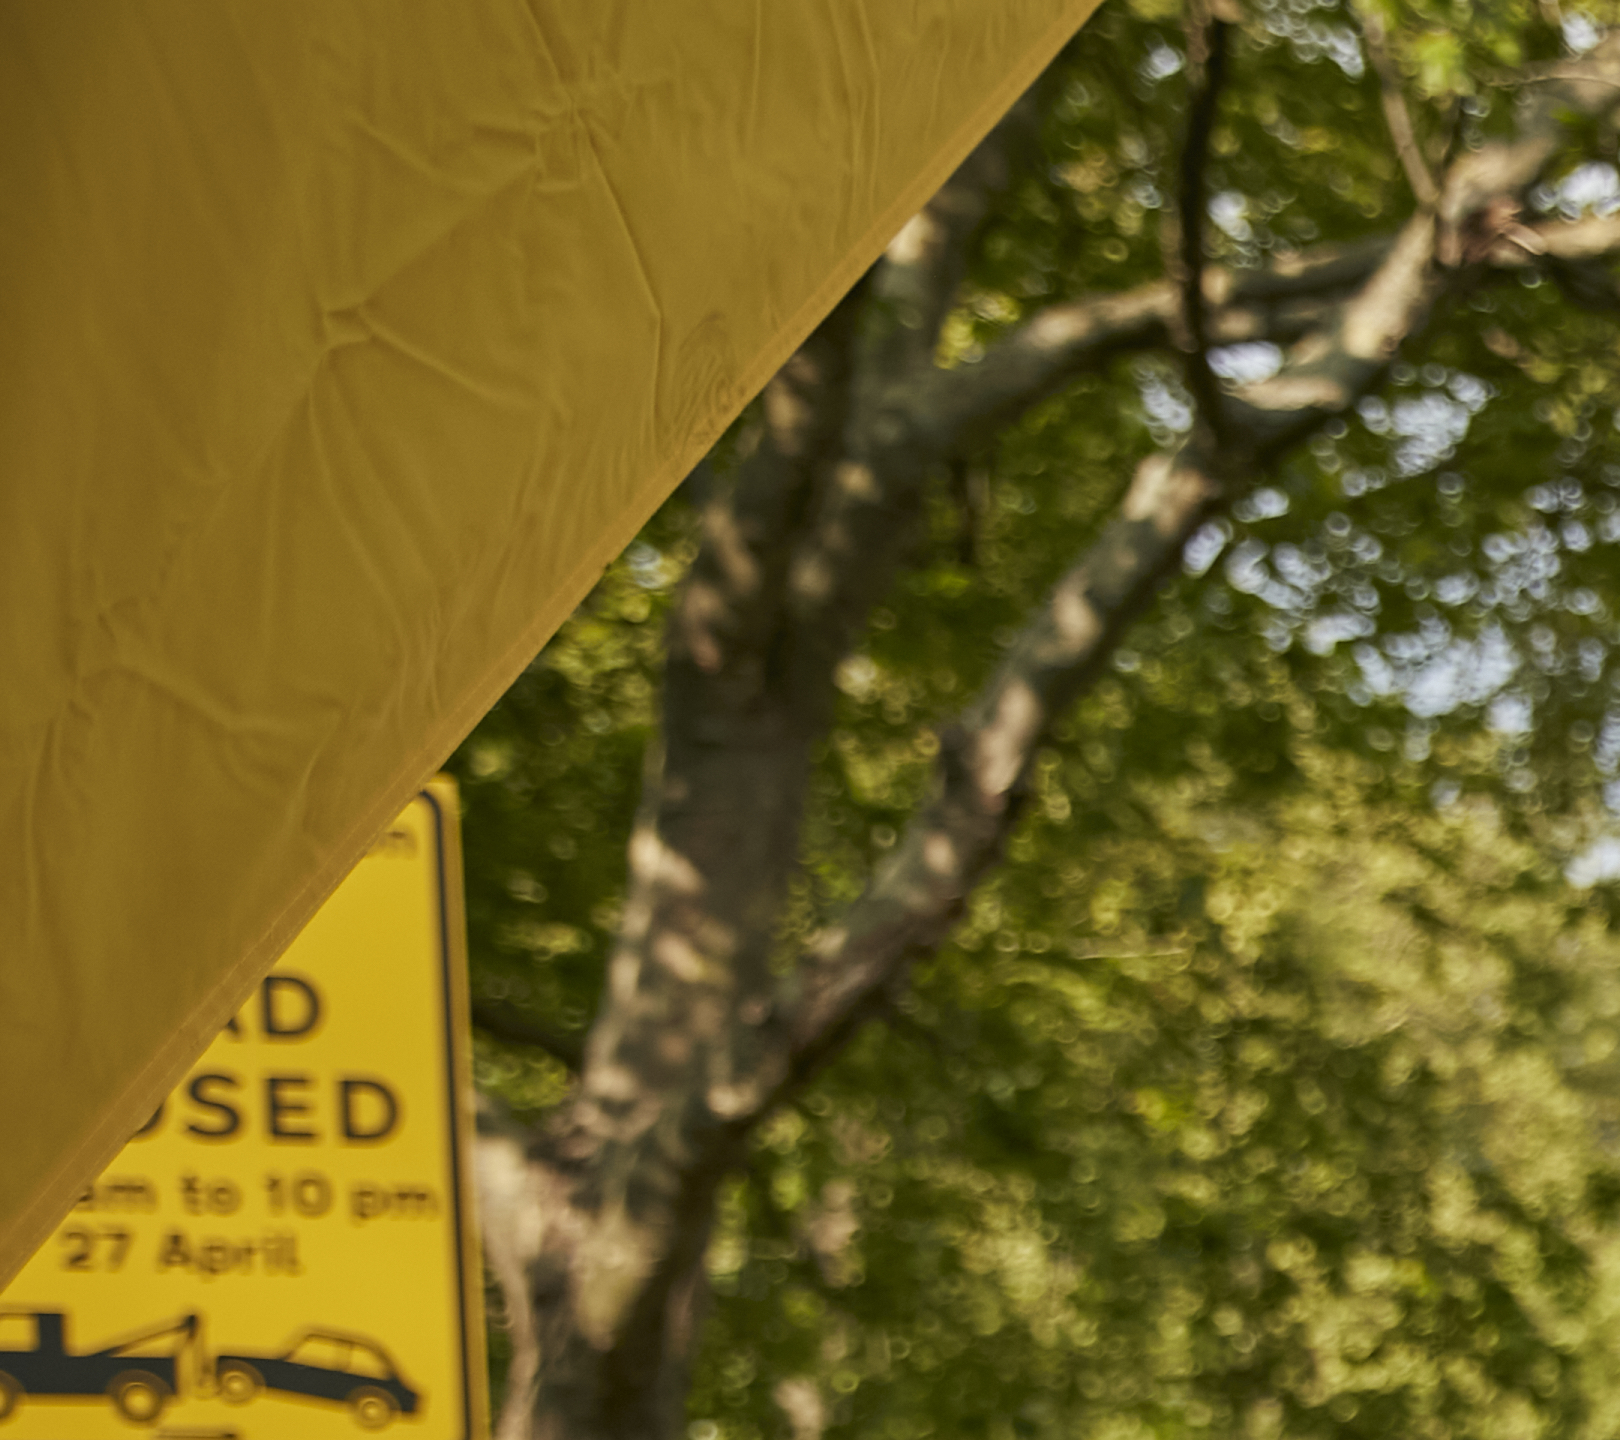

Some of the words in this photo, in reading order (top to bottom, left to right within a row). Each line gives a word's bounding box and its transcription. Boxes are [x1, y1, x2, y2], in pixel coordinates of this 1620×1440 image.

[122, 1072, 403, 1143] SED
[266, 1174, 331, 1218] 10
[62, 1228, 135, 1273] 27
